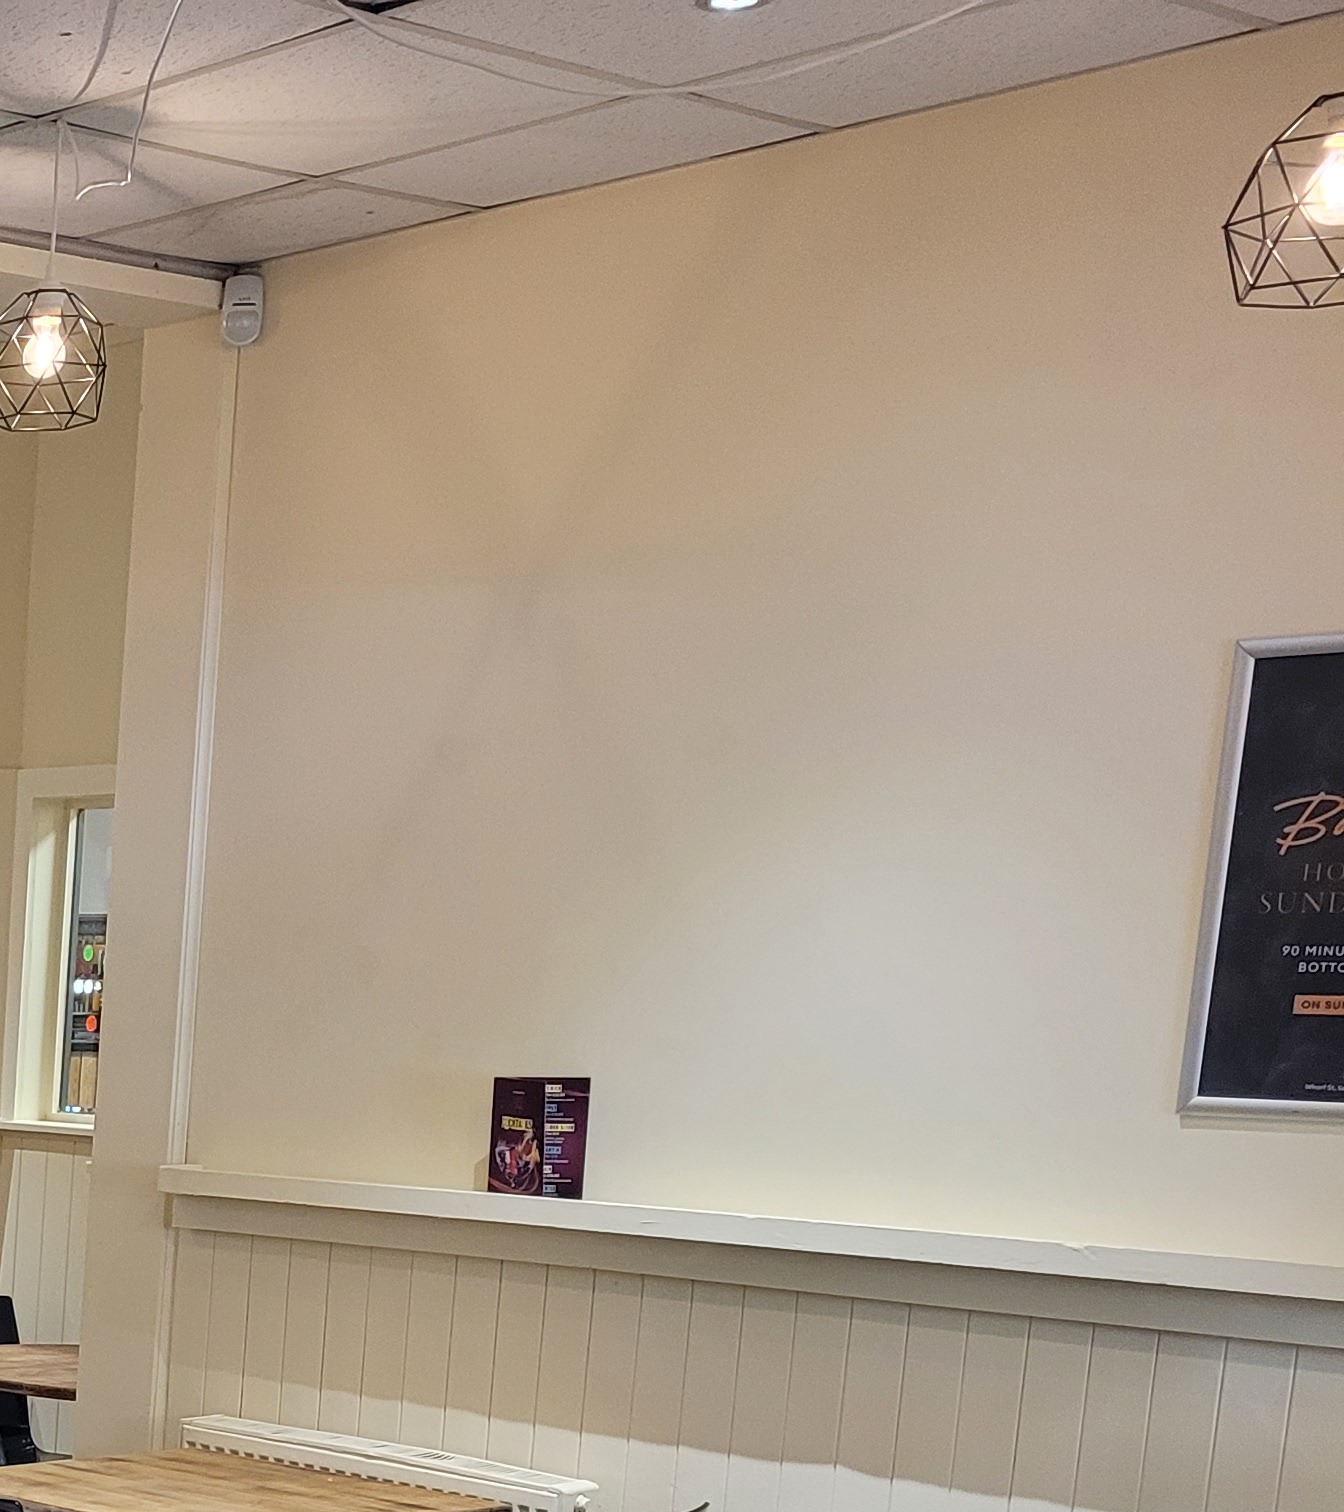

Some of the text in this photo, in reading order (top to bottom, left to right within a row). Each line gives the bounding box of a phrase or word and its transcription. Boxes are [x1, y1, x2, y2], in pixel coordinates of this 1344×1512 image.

[1282, 945, 1300, 957] 90
[1301, 1000, 1344, 1010] ON SU
